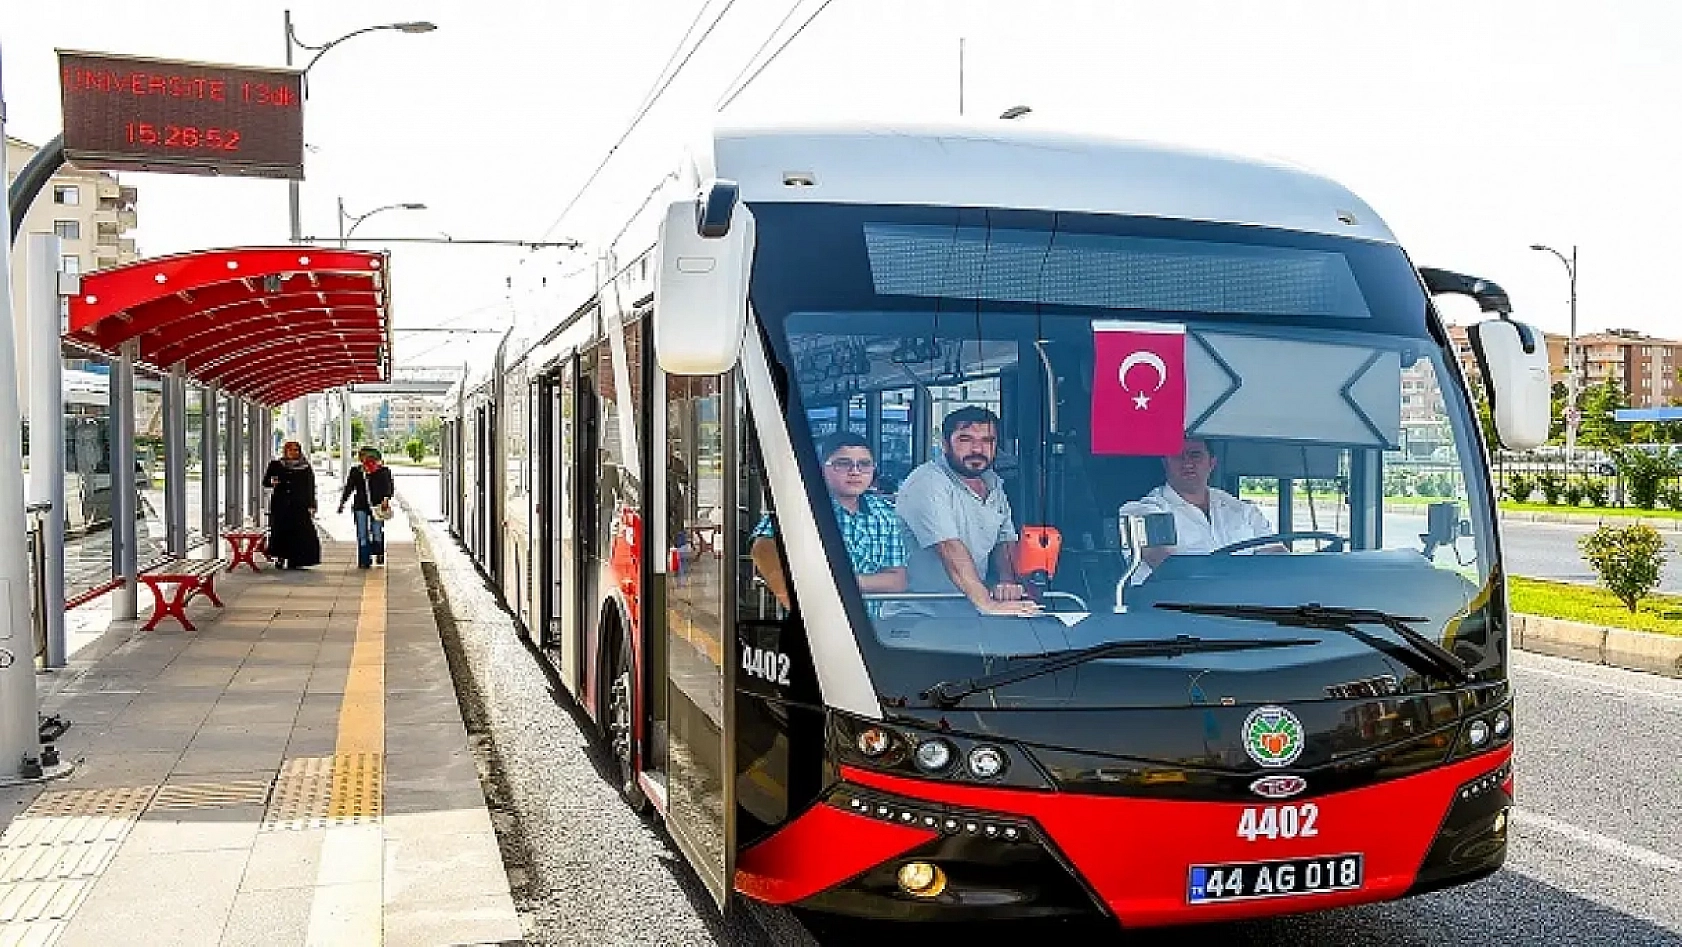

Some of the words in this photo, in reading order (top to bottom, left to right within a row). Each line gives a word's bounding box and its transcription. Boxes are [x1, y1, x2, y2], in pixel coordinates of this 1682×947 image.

[742, 645, 791, 686] 4402
[1236, 803, 1319, 841] 4402
[1206, 867, 1244, 897] 44
[1253, 865, 1296, 893] AG
[1304, 858, 1356, 888] 018
